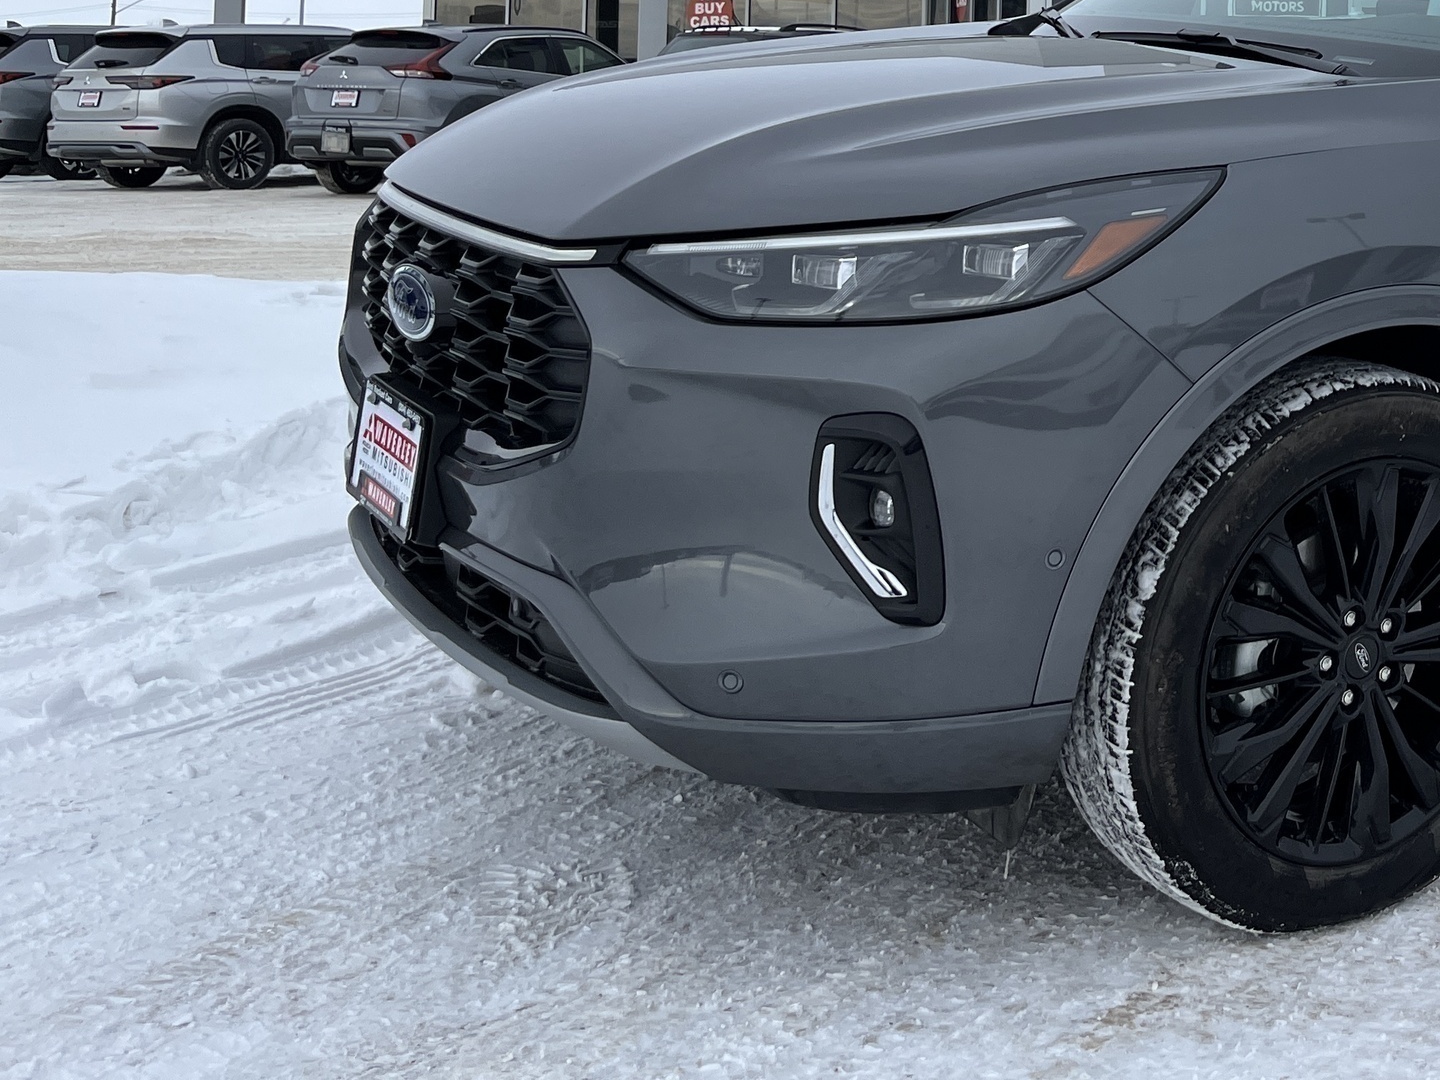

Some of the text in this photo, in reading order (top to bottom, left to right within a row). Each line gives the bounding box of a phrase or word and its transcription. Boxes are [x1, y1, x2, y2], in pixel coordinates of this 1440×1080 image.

[694, 1, 725, 14] BUY
[1250, 0, 1305, 13] MOTORS
[690, 15, 729, 28] CARS
[374, 419, 417, 468] WAVERLEY
[371, 445, 412, 489] MITSUBISHI
